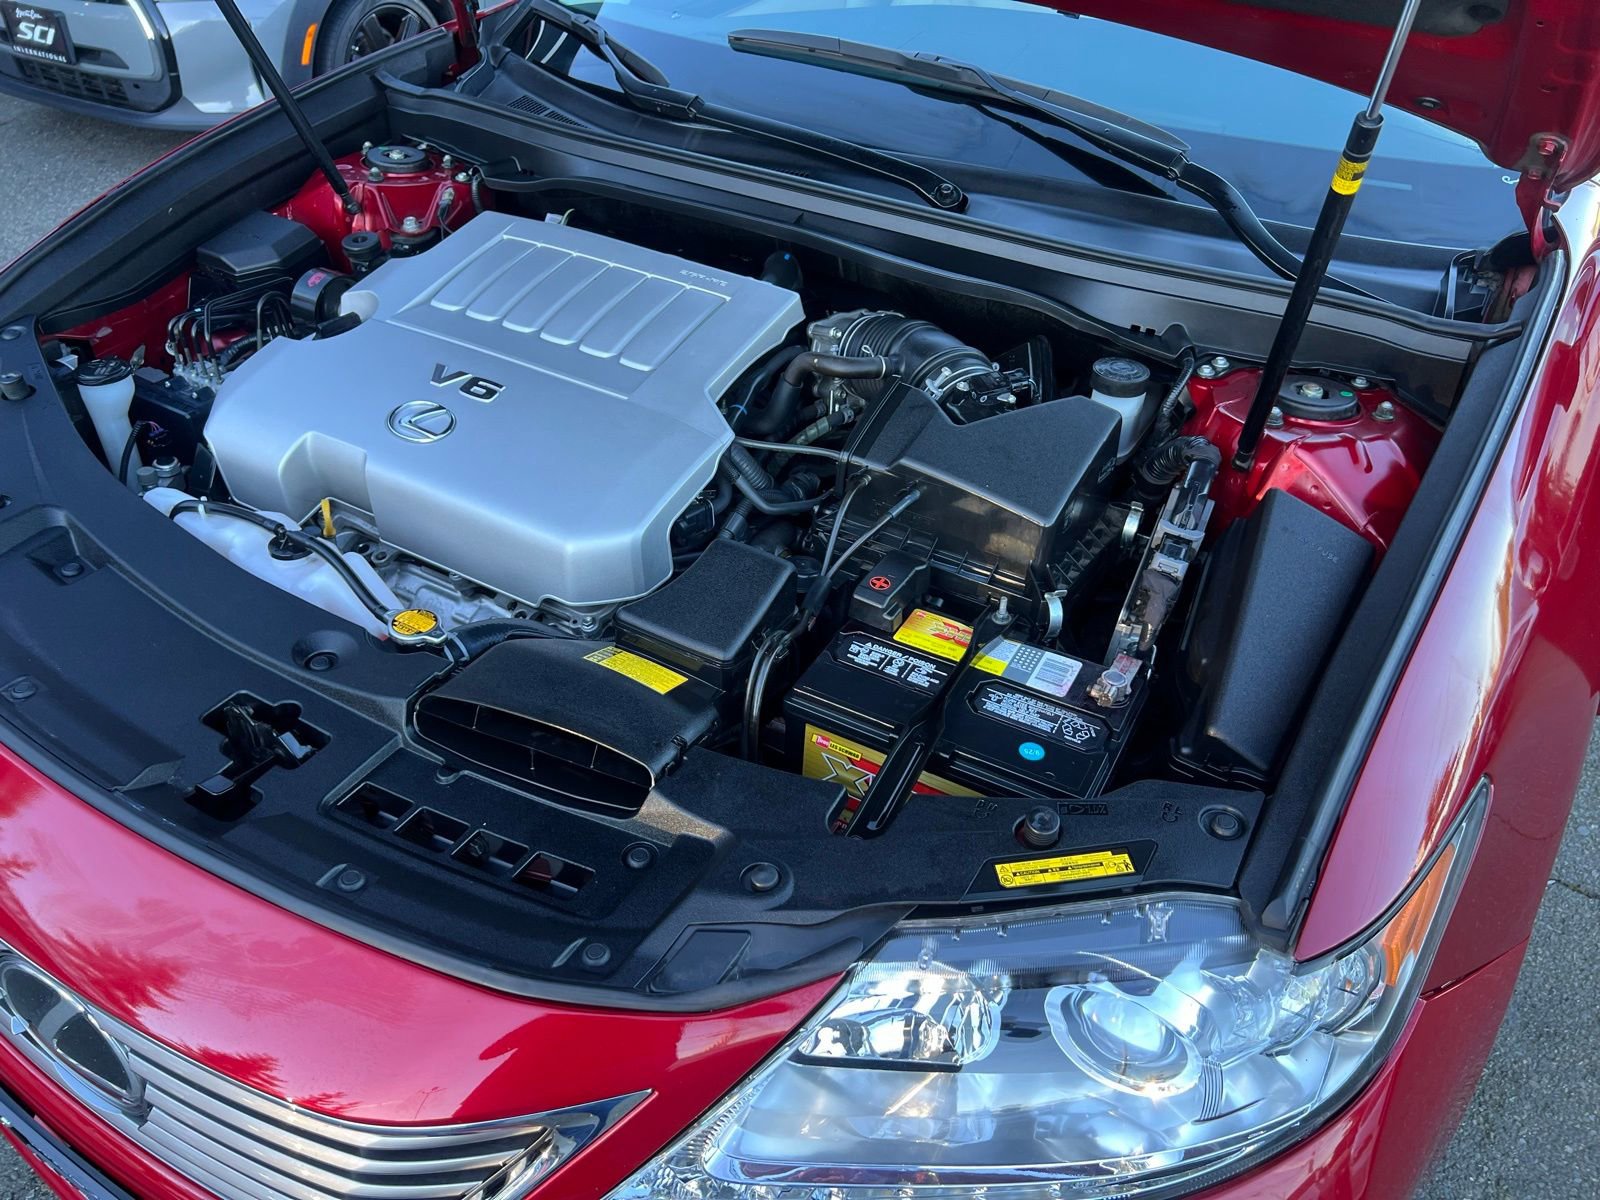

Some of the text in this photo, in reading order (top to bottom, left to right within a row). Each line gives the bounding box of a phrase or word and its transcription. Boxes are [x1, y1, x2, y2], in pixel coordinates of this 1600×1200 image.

[17, 21, 55, 45] SCI
[13, 45, 67, 63] INTERNATIONAL
[429, 362, 506, 403] V6
[872, 643, 903, 658] DANGER
[908, 656, 937, 670] POISON
